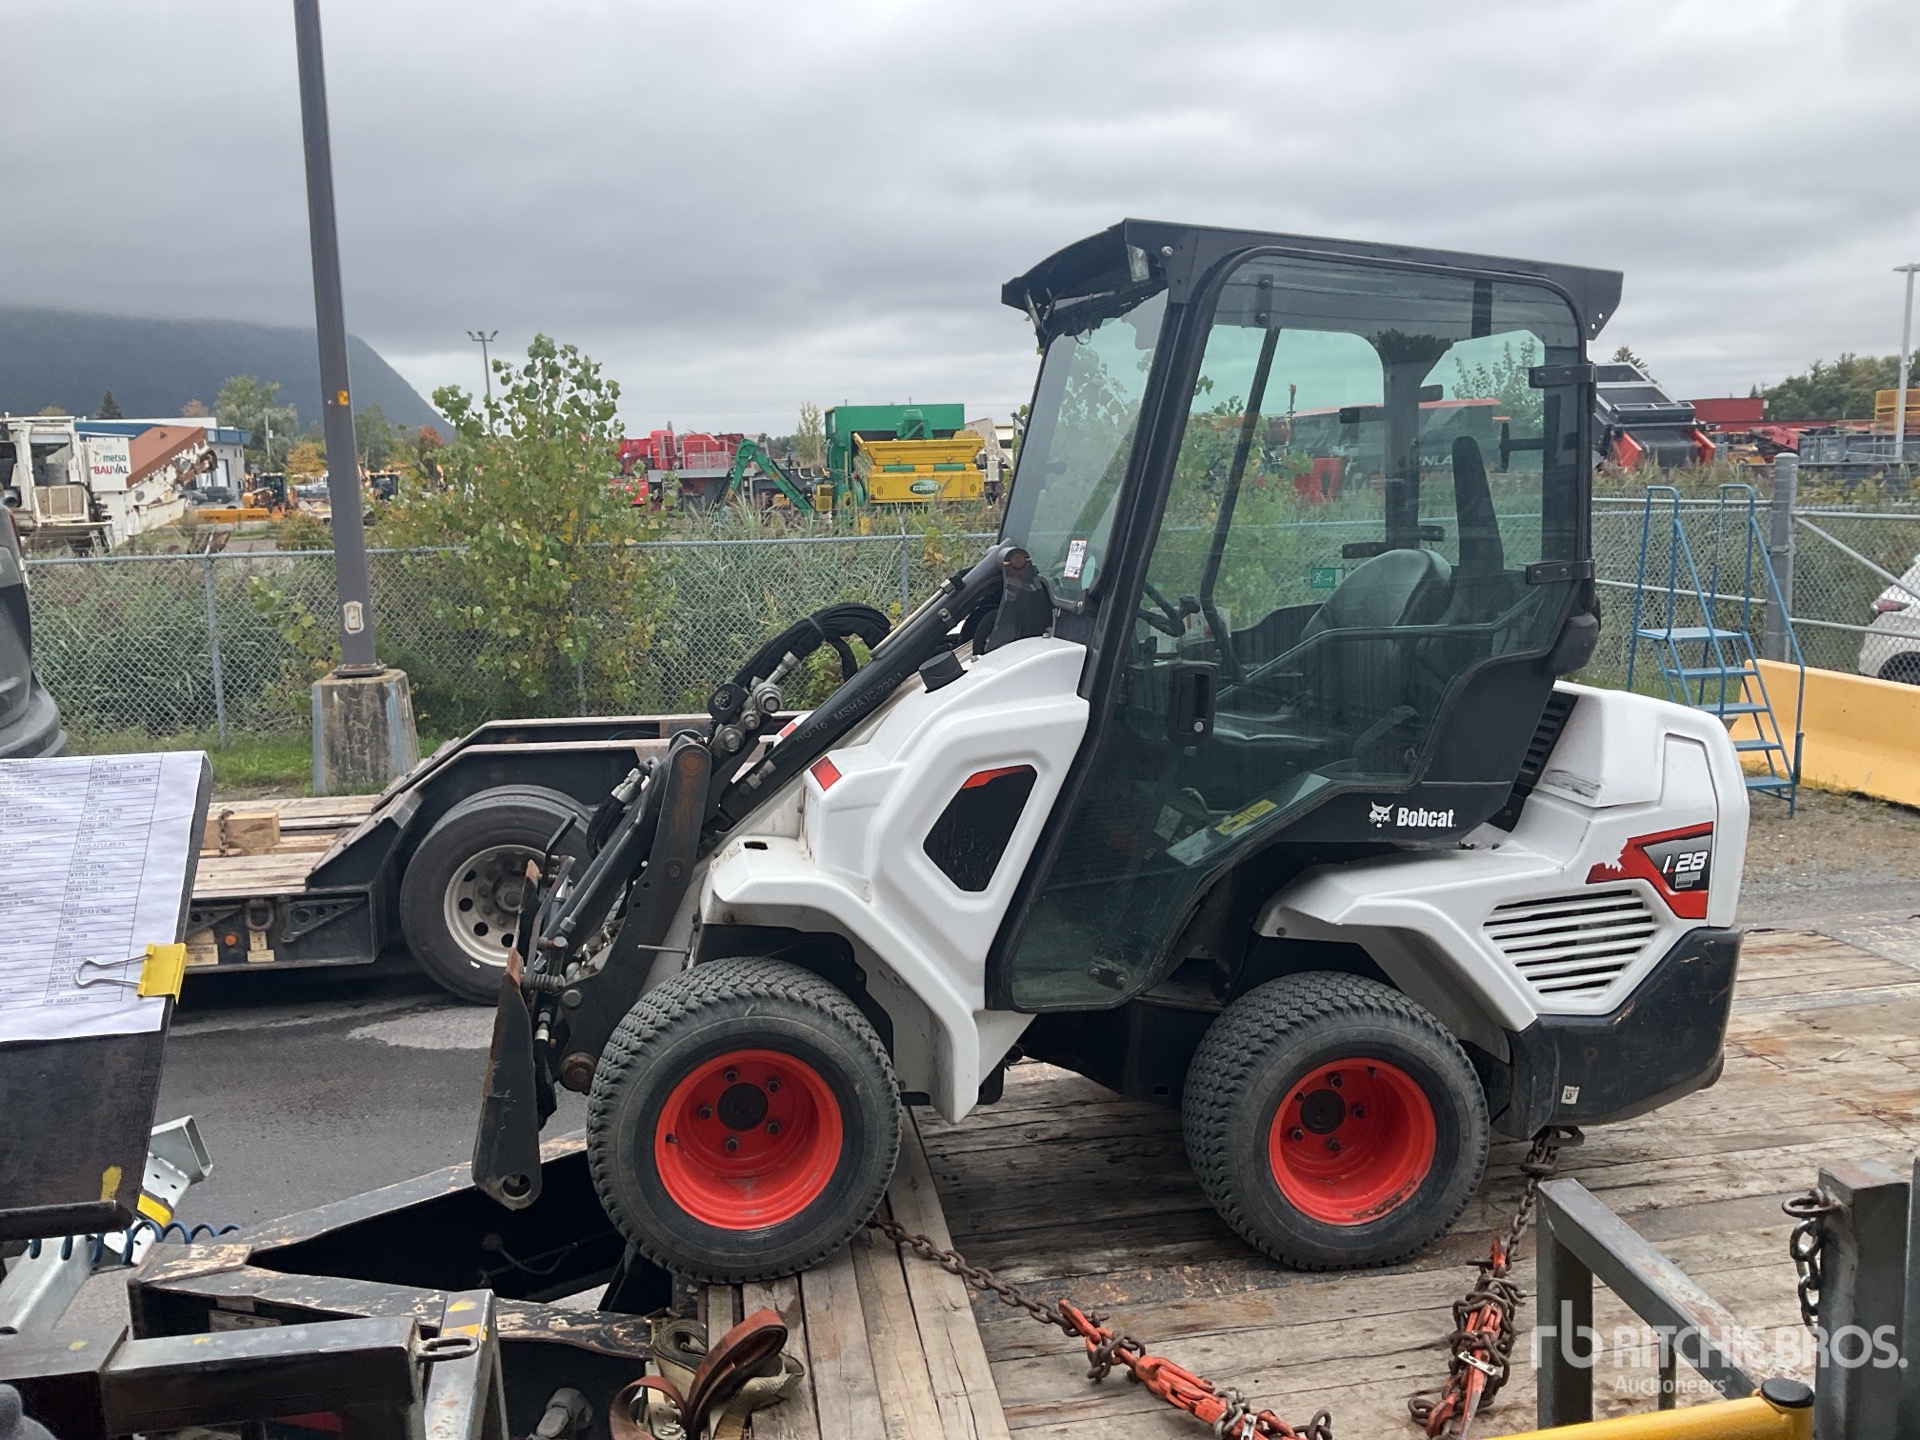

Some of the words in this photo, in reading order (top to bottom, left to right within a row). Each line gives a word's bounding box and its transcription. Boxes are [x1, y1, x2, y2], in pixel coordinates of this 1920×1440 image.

[103, 454, 127, 462] metso
[94, 464, 129, 474] BAUVAL
[833, 699, 866, 721] MSHA
[1396, 807, 1454, 828] Bobcat
